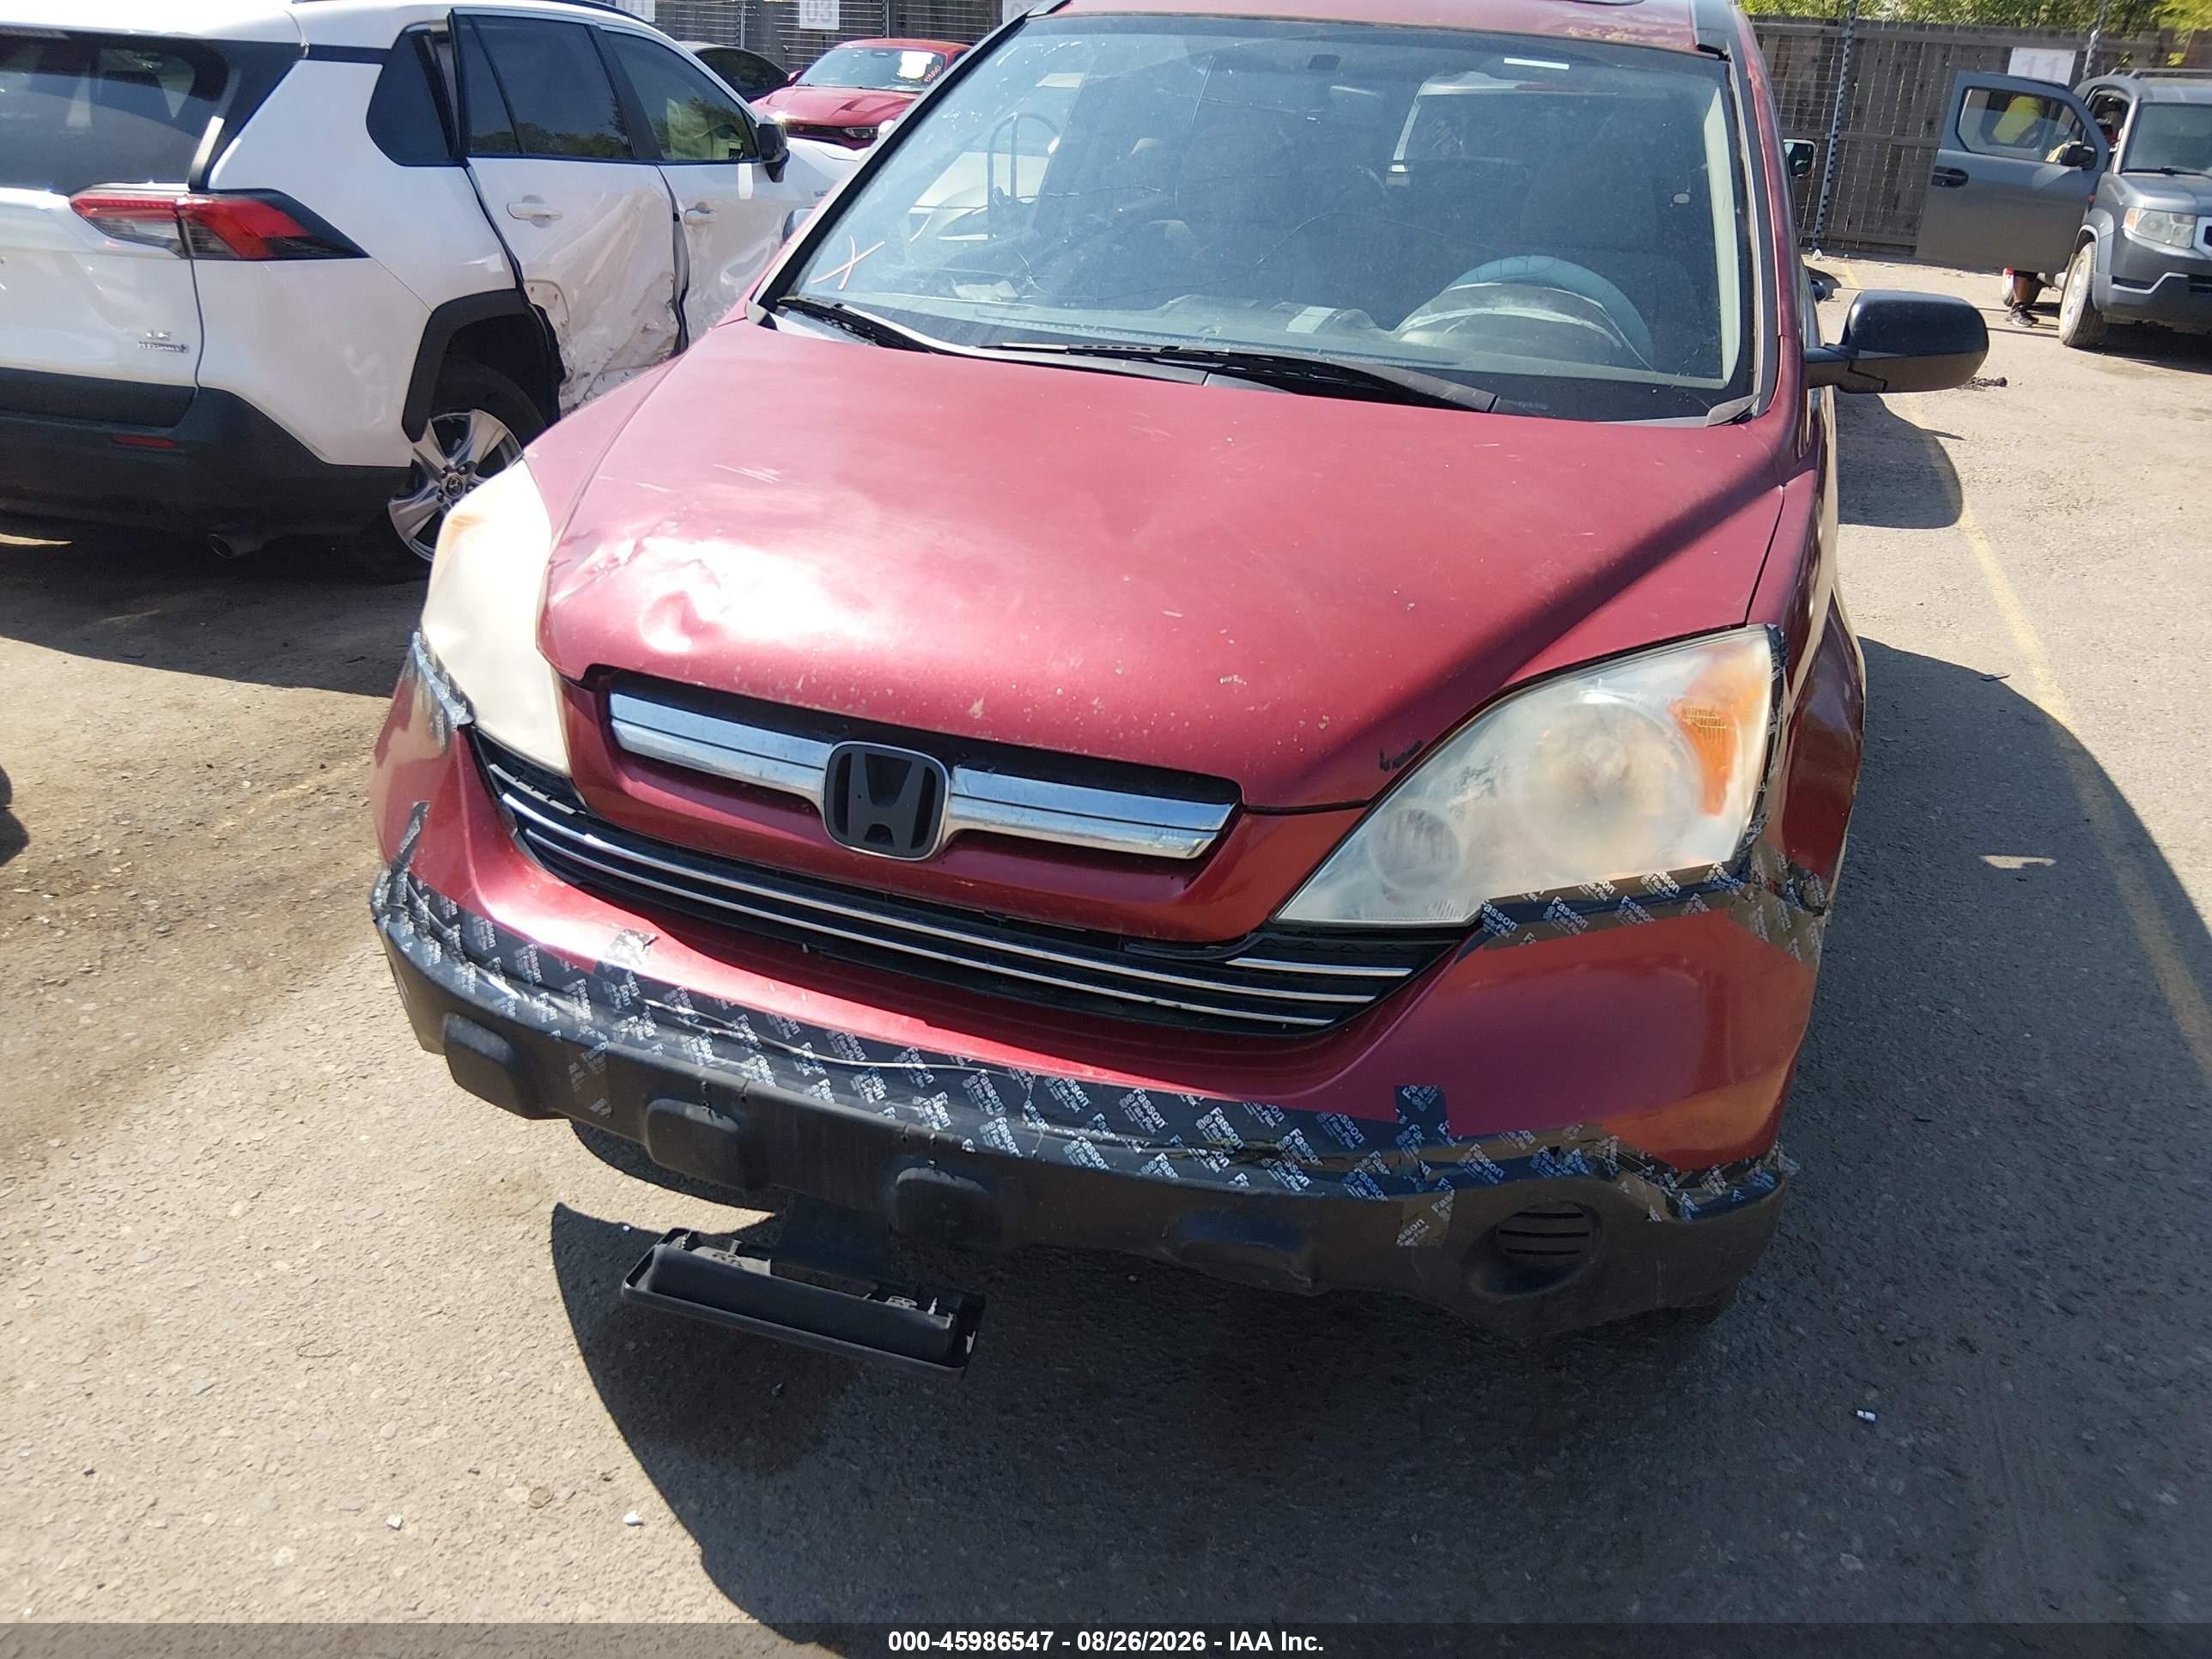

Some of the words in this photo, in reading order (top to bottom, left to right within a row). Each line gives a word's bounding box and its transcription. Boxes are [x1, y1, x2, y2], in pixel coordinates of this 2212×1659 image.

[1551, 895, 1589, 929] Fasson
[1133, 1088, 1167, 1129] Fasson
[1209, 1106, 1245, 1151] Fasson
